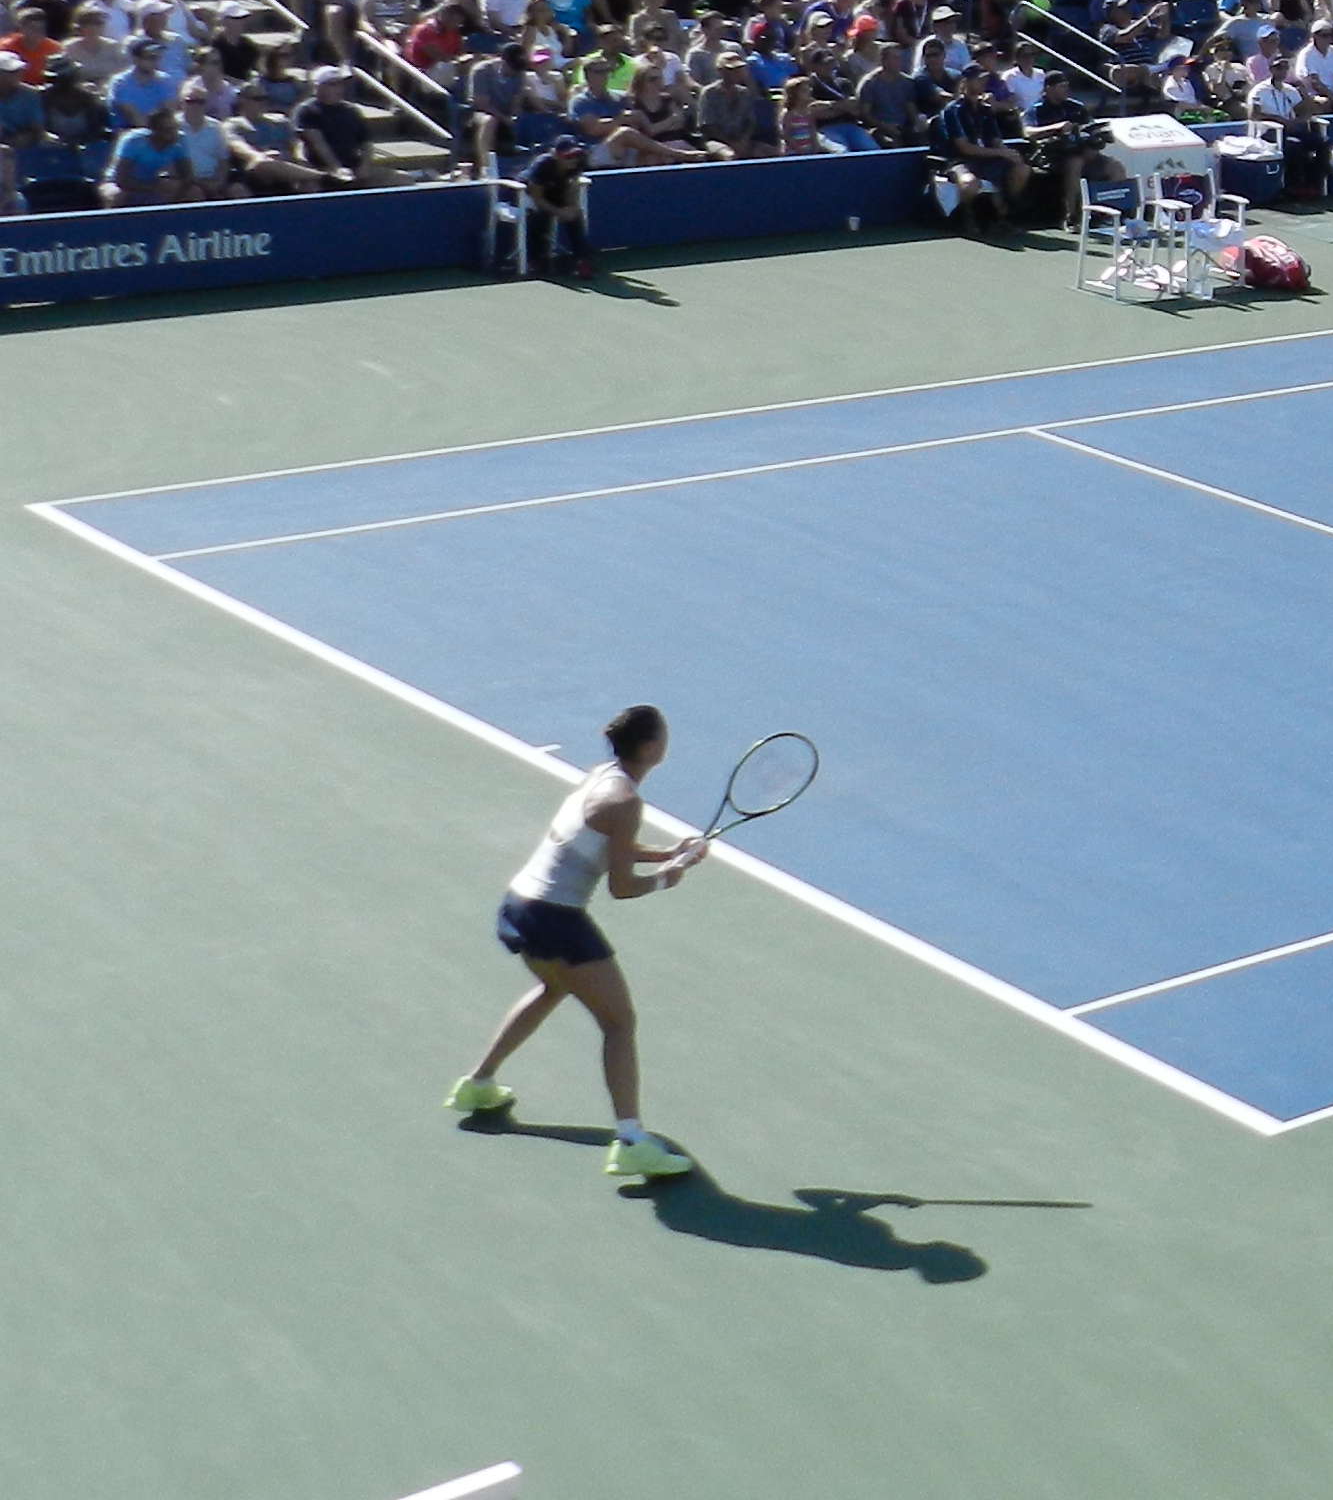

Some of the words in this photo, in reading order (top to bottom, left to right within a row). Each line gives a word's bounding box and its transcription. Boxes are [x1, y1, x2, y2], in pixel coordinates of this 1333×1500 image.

[1129, 129, 1184, 141] evian
[0, 242, 148, 278] Emirates
[157, 229, 272, 265] Airline
